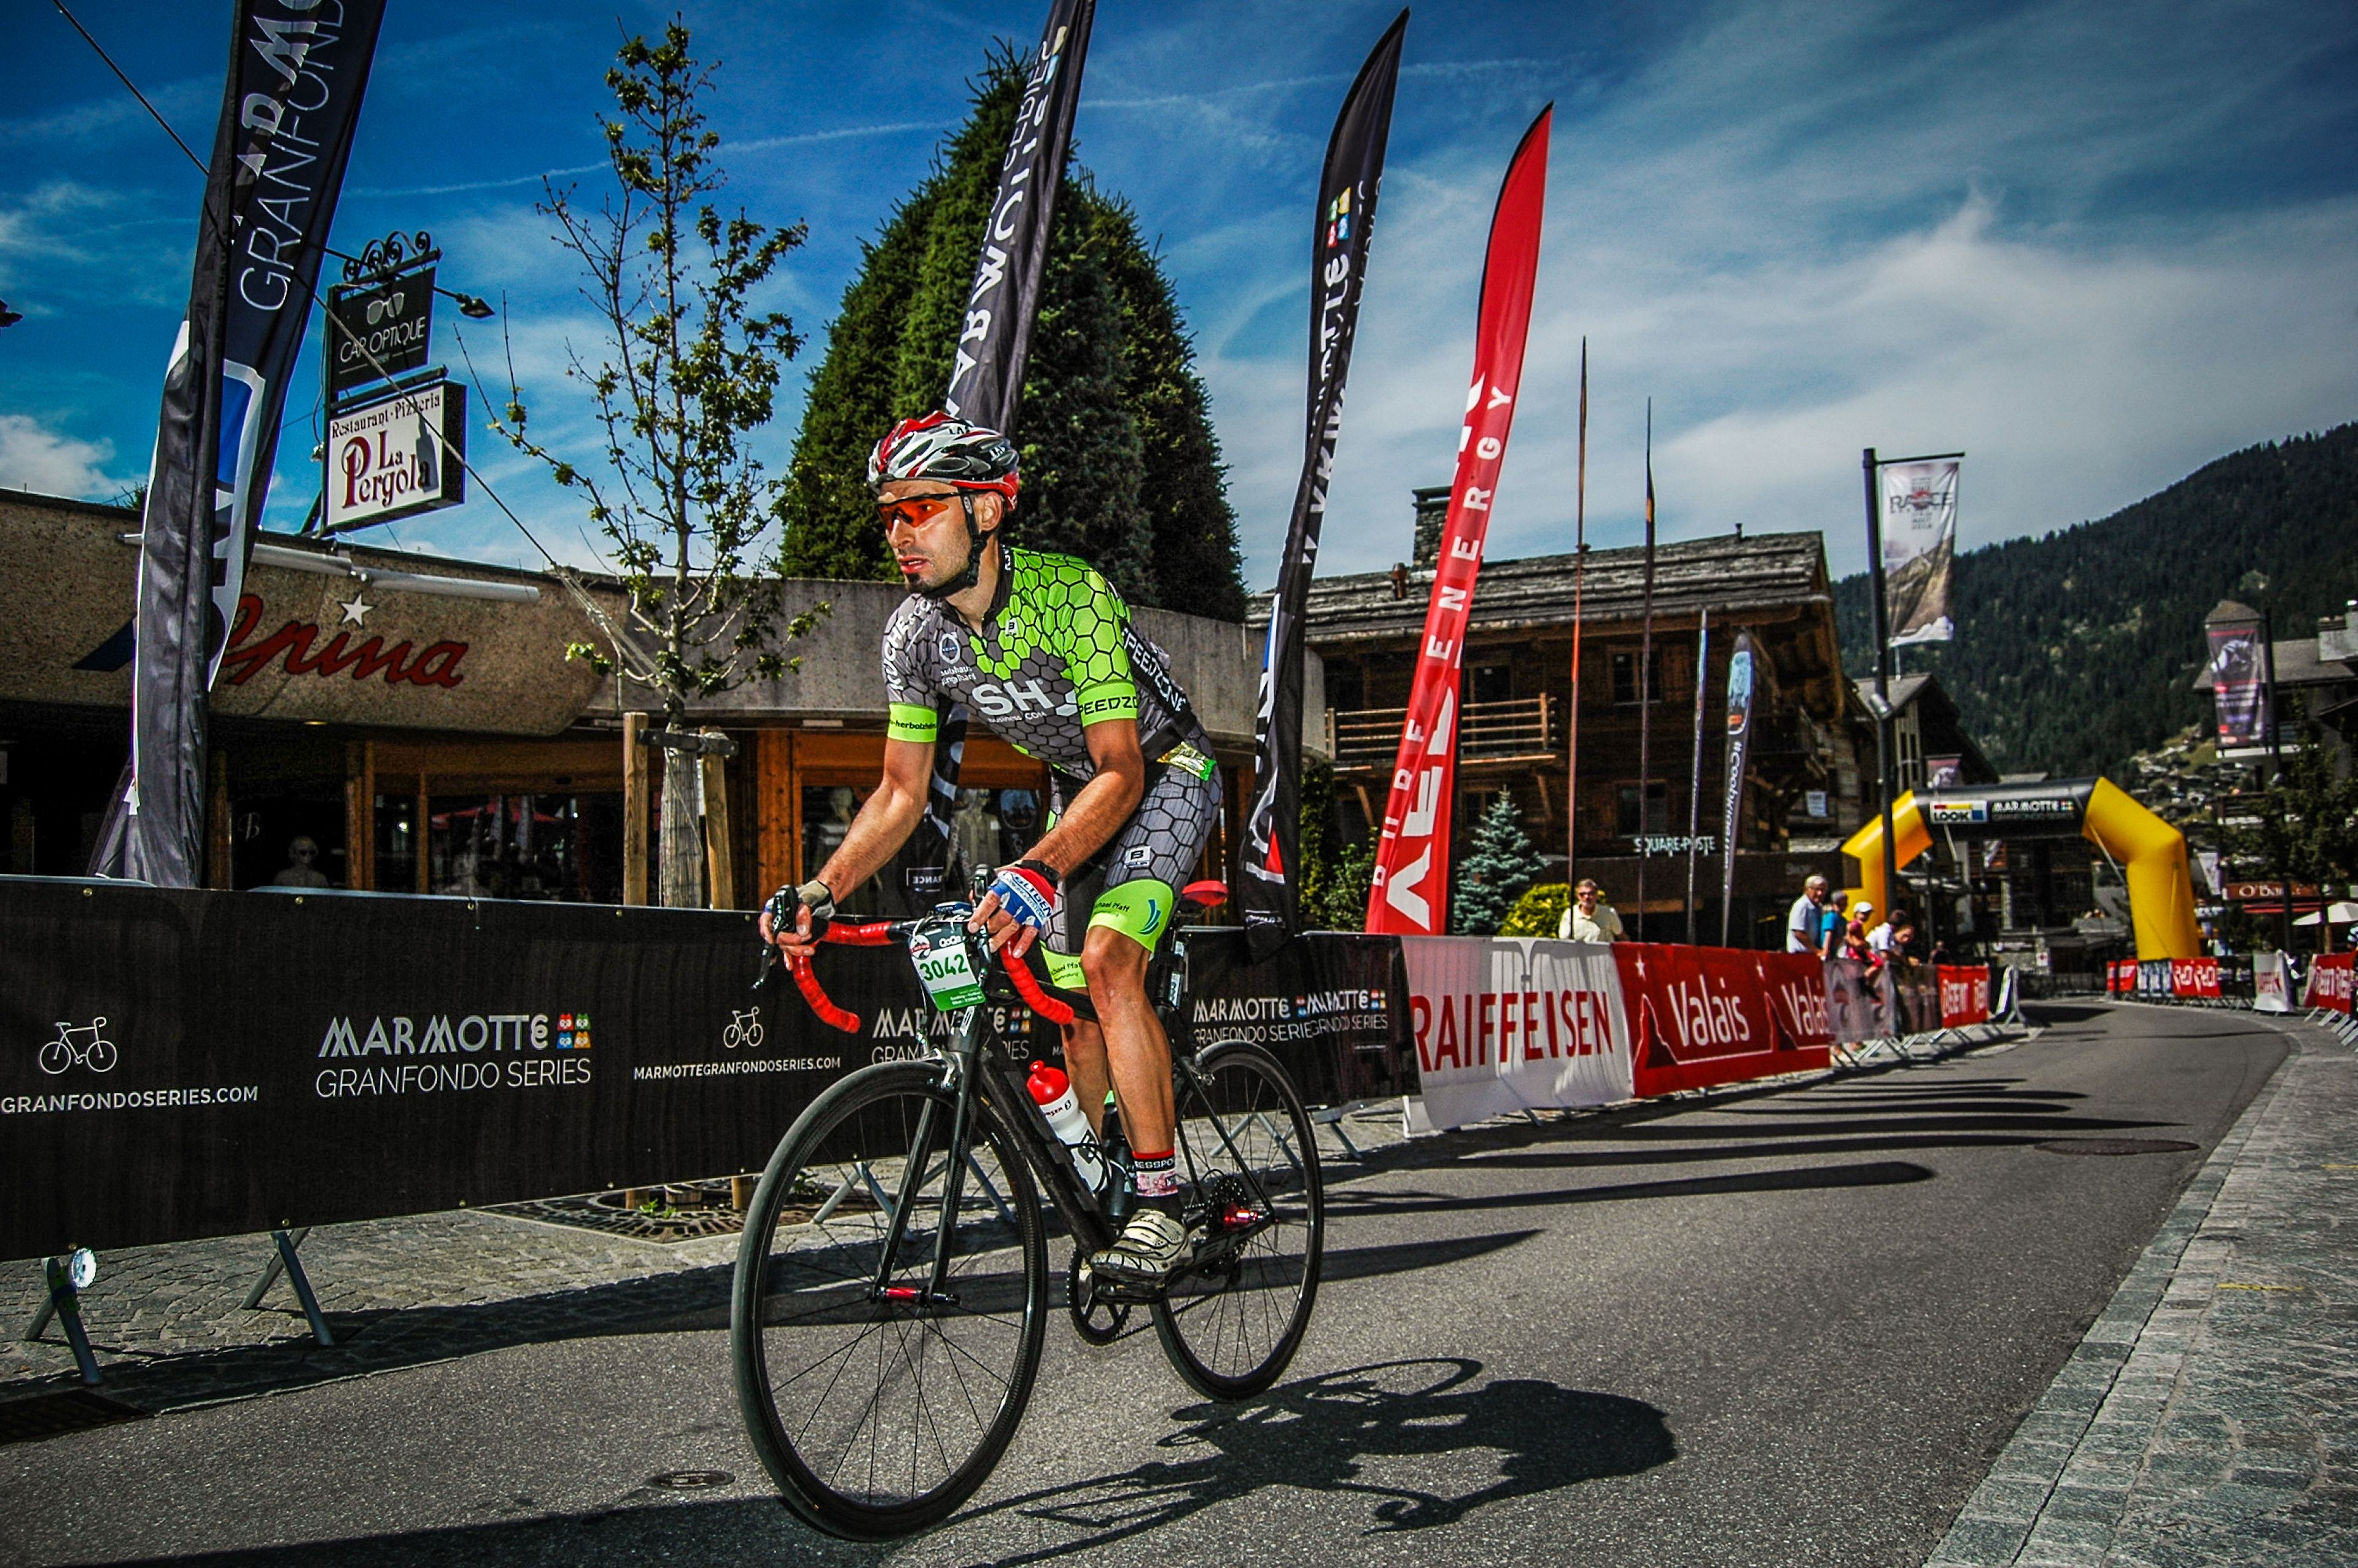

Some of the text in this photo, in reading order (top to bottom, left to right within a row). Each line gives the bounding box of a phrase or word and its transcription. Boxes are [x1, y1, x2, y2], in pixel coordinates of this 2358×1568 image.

[370, 316, 426, 353] OPTIQUE
[332, 409, 389, 438] Restaurant
[378, 430, 402, 469] La
[341, 435, 429, 510] Pergola
[1426, 386, 1512, 661] ENERGY
[222, 593, 470, 689] lpina
[1934, 812, 1970, 821] LOOK
[919, 953, 968, 981] 3042
[1193, 997, 1291, 1022] MARMOTTE
[1668, 974, 1750, 1047] Valais
[318, 1014, 548, 1057] MARMOTTE
[1269, 1022, 1314, 1042] SERIE
[1410, 990, 1613, 1073] RAIFFEISEN
[316, 1058, 591, 1098] GRANFONDO SERIES
[634, 1056, 841, 1081] MARMOTTEGRANFONDOSERIES.COM
[1, 1085, 259, 1114] GRANFONDOSERIES.COM
